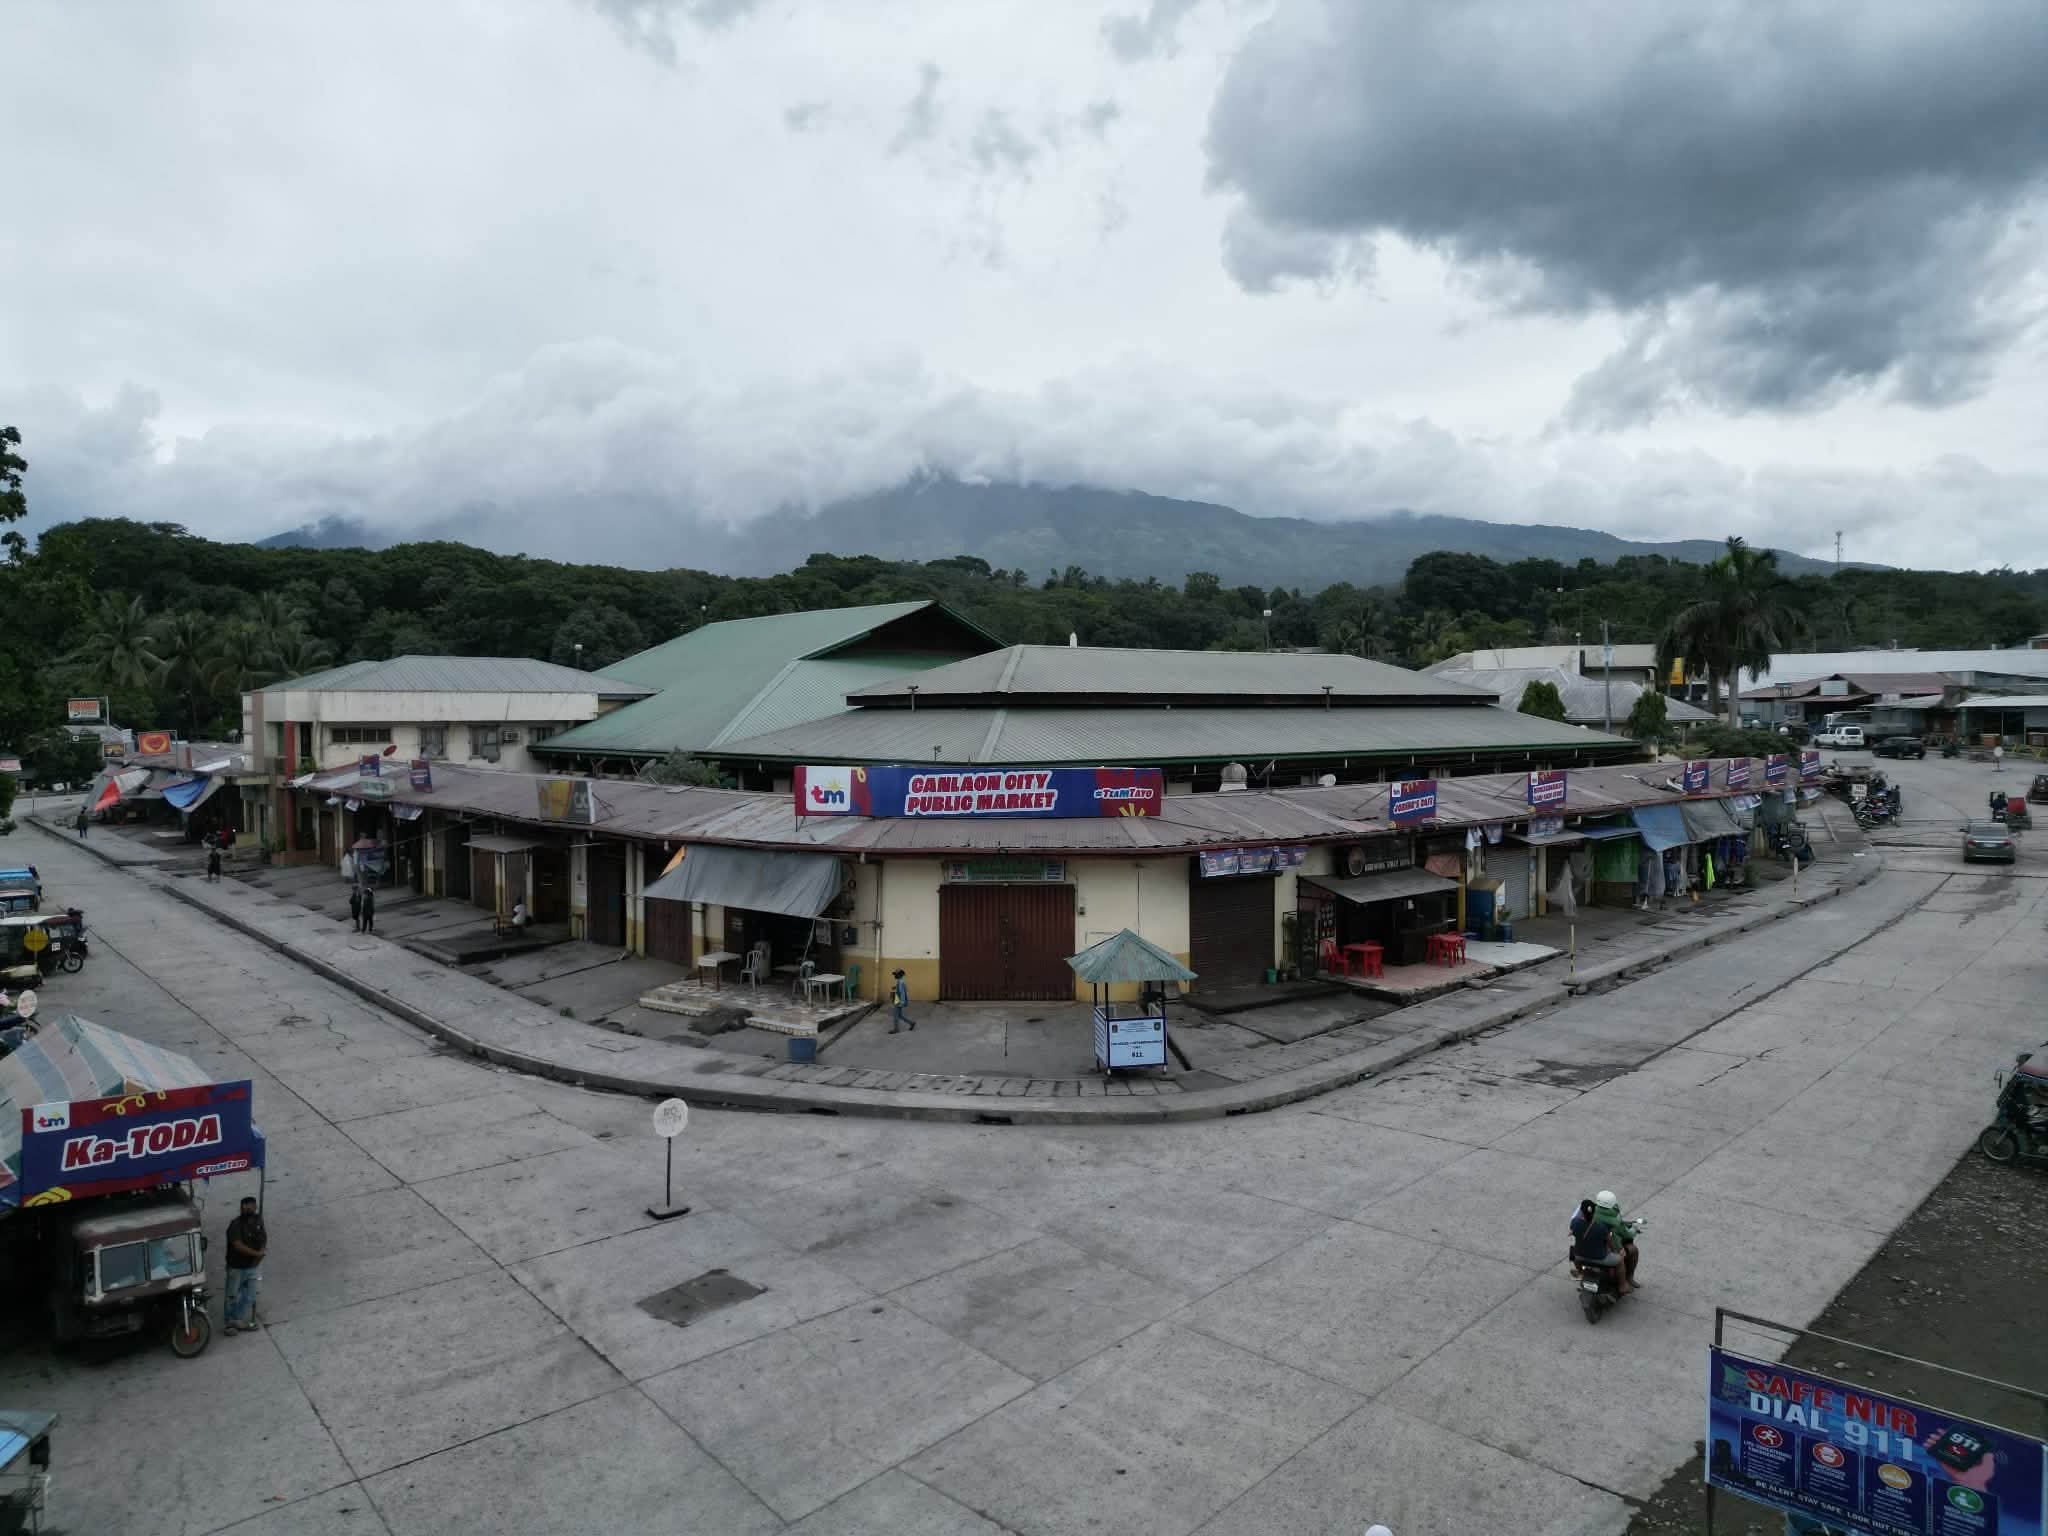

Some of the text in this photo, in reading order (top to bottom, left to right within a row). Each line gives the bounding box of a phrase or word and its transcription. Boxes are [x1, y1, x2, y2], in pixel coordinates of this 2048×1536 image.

[911, 771, 1050, 794] CANLAON CITY
[811, 785, 845, 804] tm
[907, 791, 1056, 813] PUBLIC MARKET
[37, 1116, 65, 1128] tm
[64, 1115, 221, 1171] Ka-TODA
[1745, 1368, 1917, 1437] SAFE NIR
[1750, 1391, 1913, 1462] DIAL 911
[1949, 1432, 1981, 1452] 911
